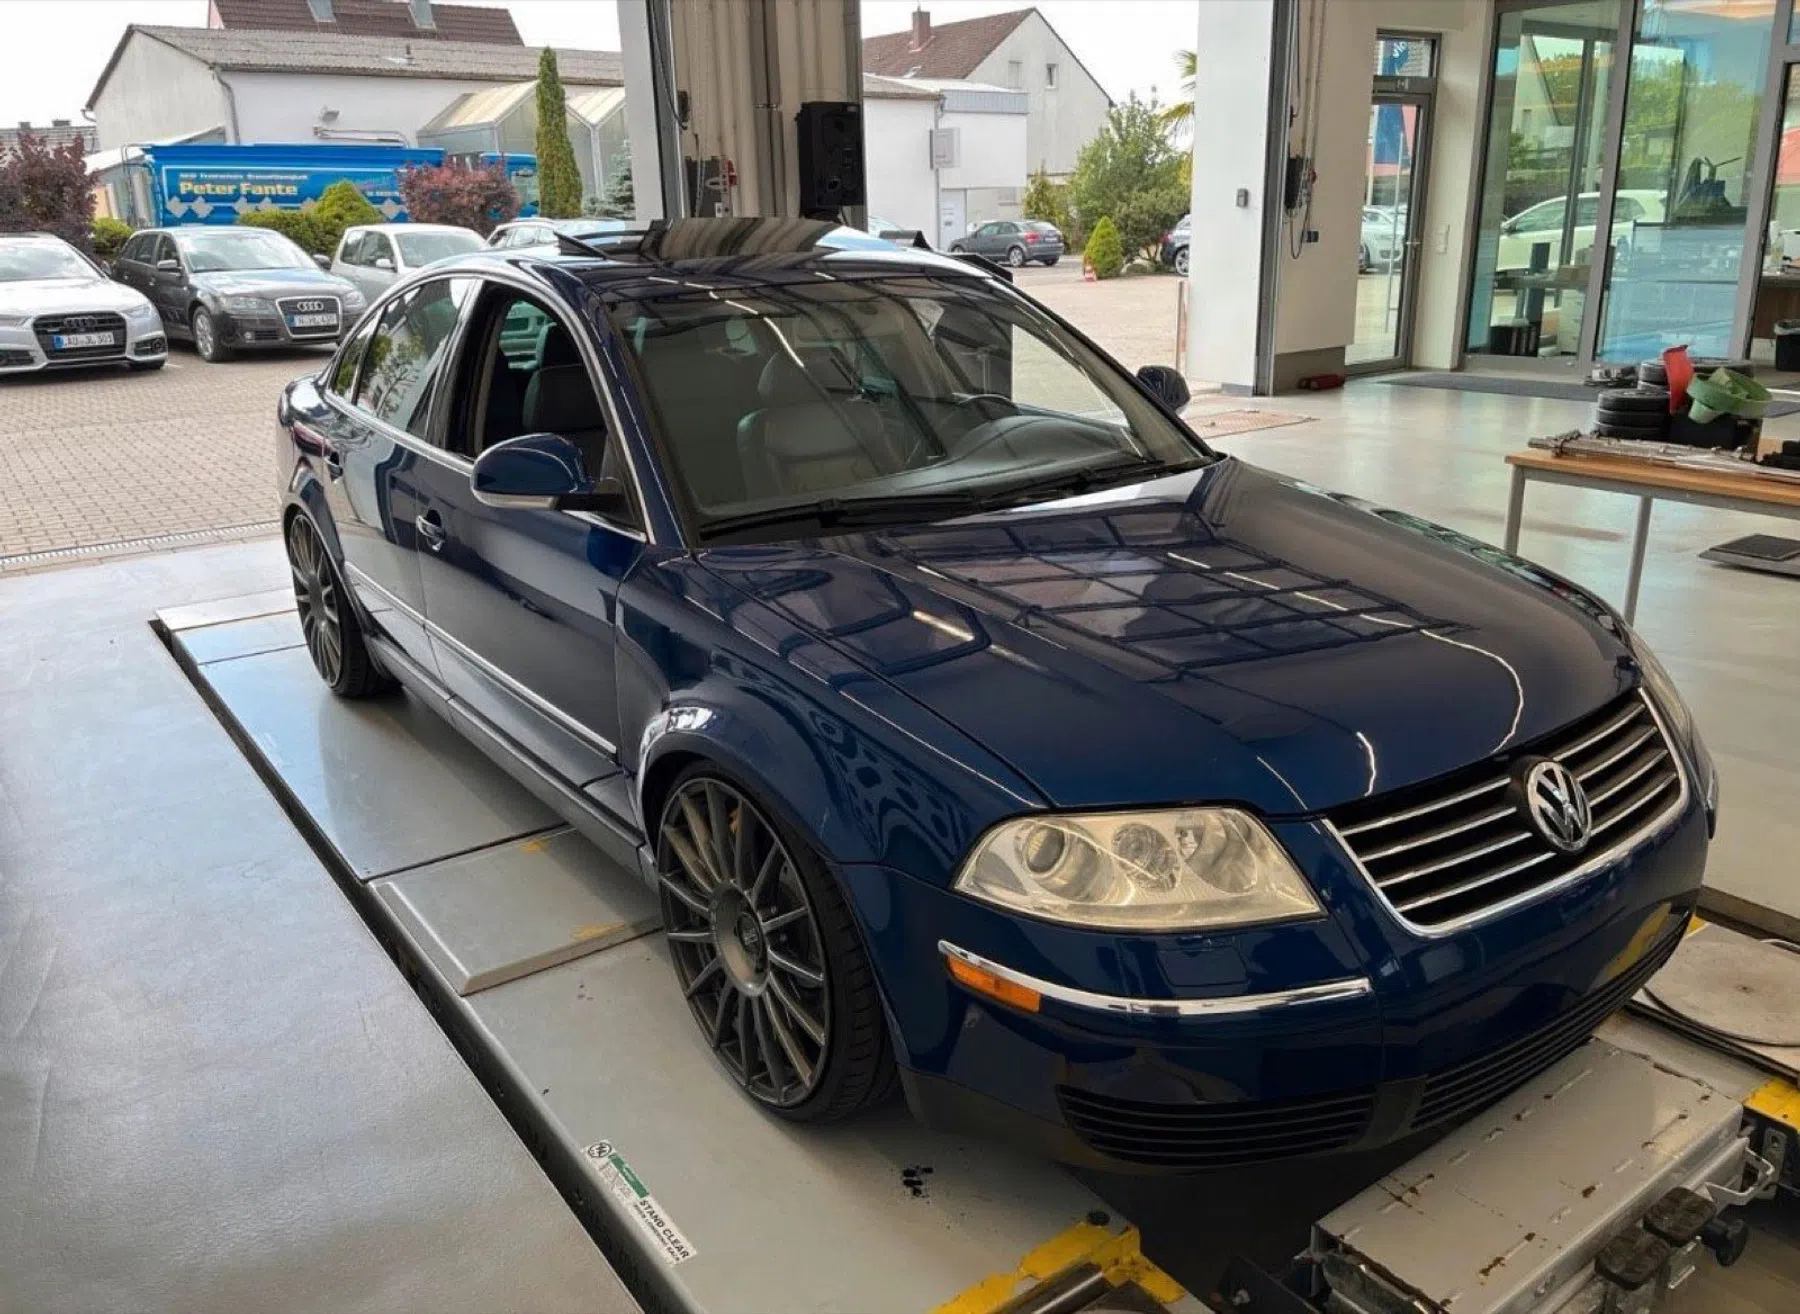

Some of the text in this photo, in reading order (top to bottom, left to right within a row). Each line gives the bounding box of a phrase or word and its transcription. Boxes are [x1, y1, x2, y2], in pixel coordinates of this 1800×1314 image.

[179, 181, 237, 195] Peter
[640, 1200, 690, 1259] STAND CLEAR
